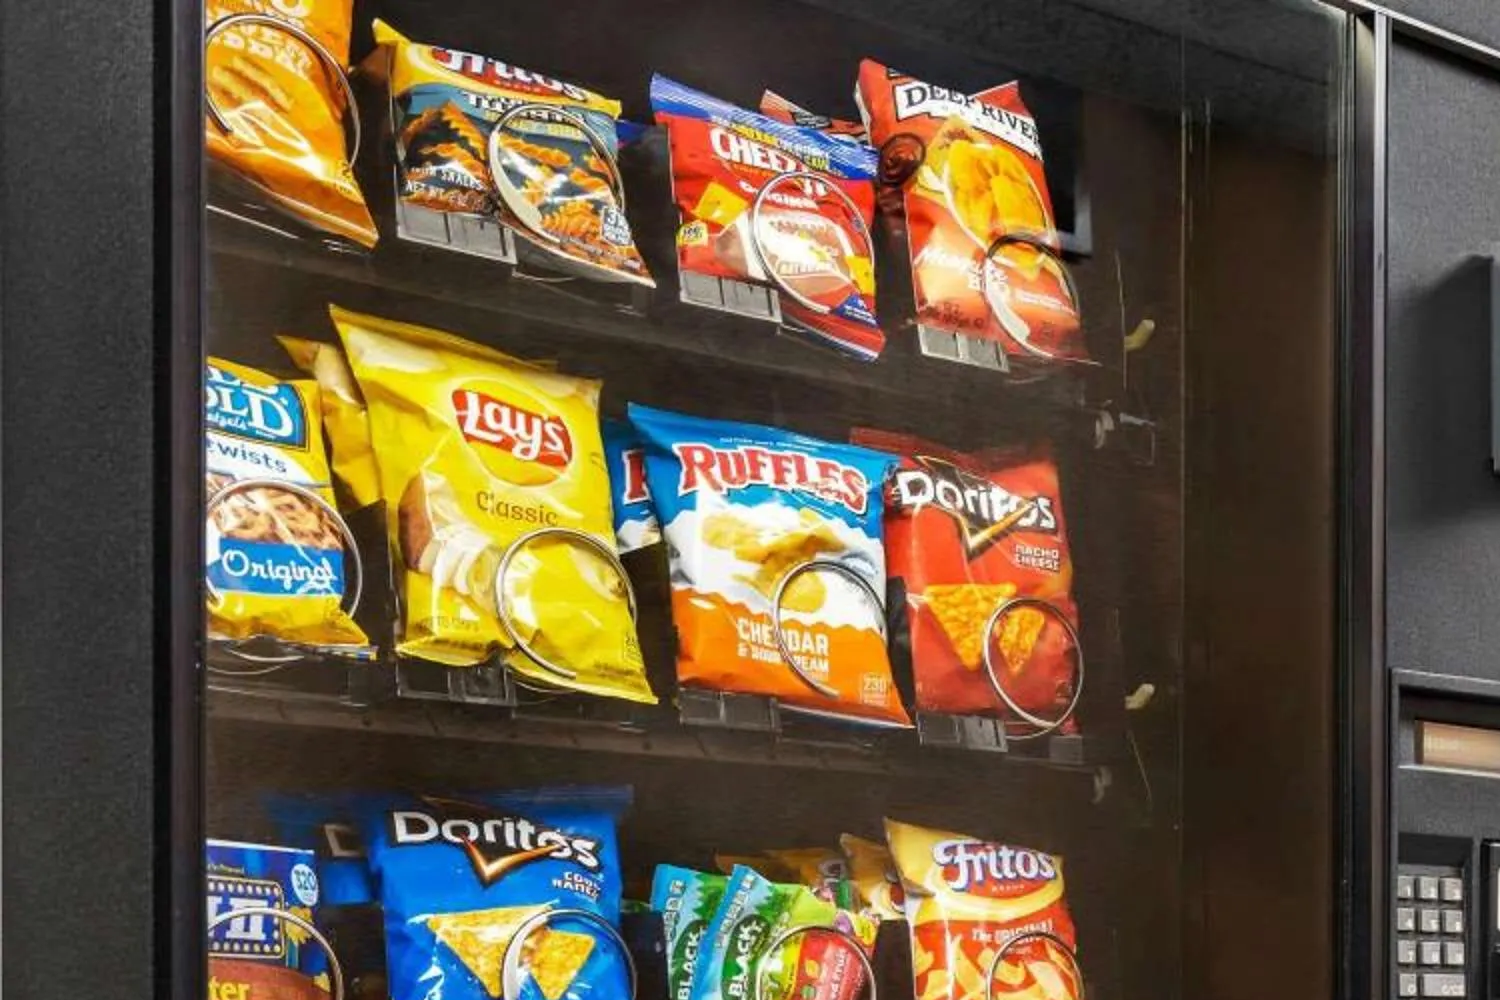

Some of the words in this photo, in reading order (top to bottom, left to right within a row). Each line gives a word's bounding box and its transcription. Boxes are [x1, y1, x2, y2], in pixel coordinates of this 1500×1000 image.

[672, 442, 868, 515] RUFFLES
[476, 490, 558, 528] Classic
[222, 549, 339, 591] Original
[736, 617, 829, 657] CHEDAR
[392, 811, 601, 868] Doritos
[932, 838, 1057, 892] Fritos
